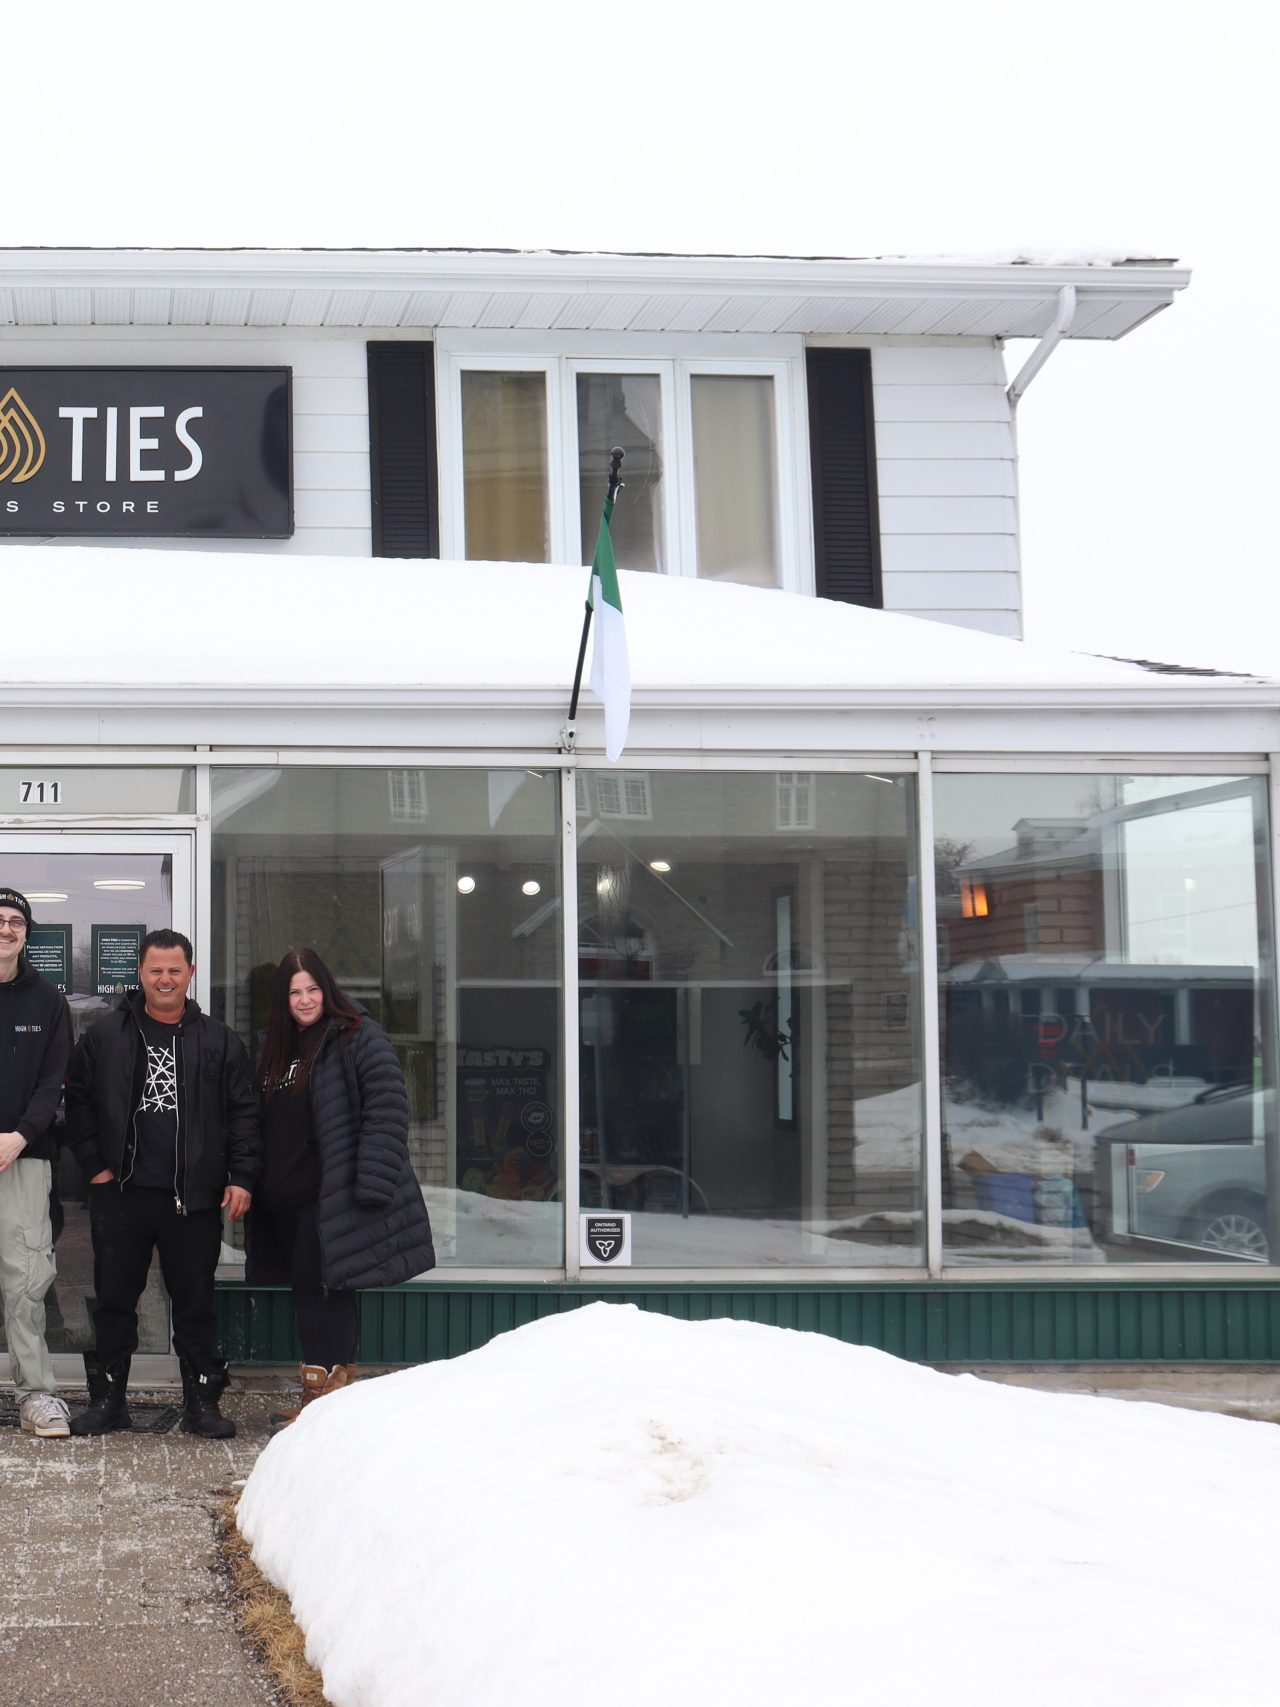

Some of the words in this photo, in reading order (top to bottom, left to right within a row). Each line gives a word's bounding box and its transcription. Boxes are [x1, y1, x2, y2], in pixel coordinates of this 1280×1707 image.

[58, 406, 203, 482] TIES
[53, 501, 160, 514] STORE
[21, 781, 58, 802] 711
[97, 984, 115, 994] HIGH
[491, 1078, 511, 1086] MAX
[496, 1087, 516, 1095] MAX
